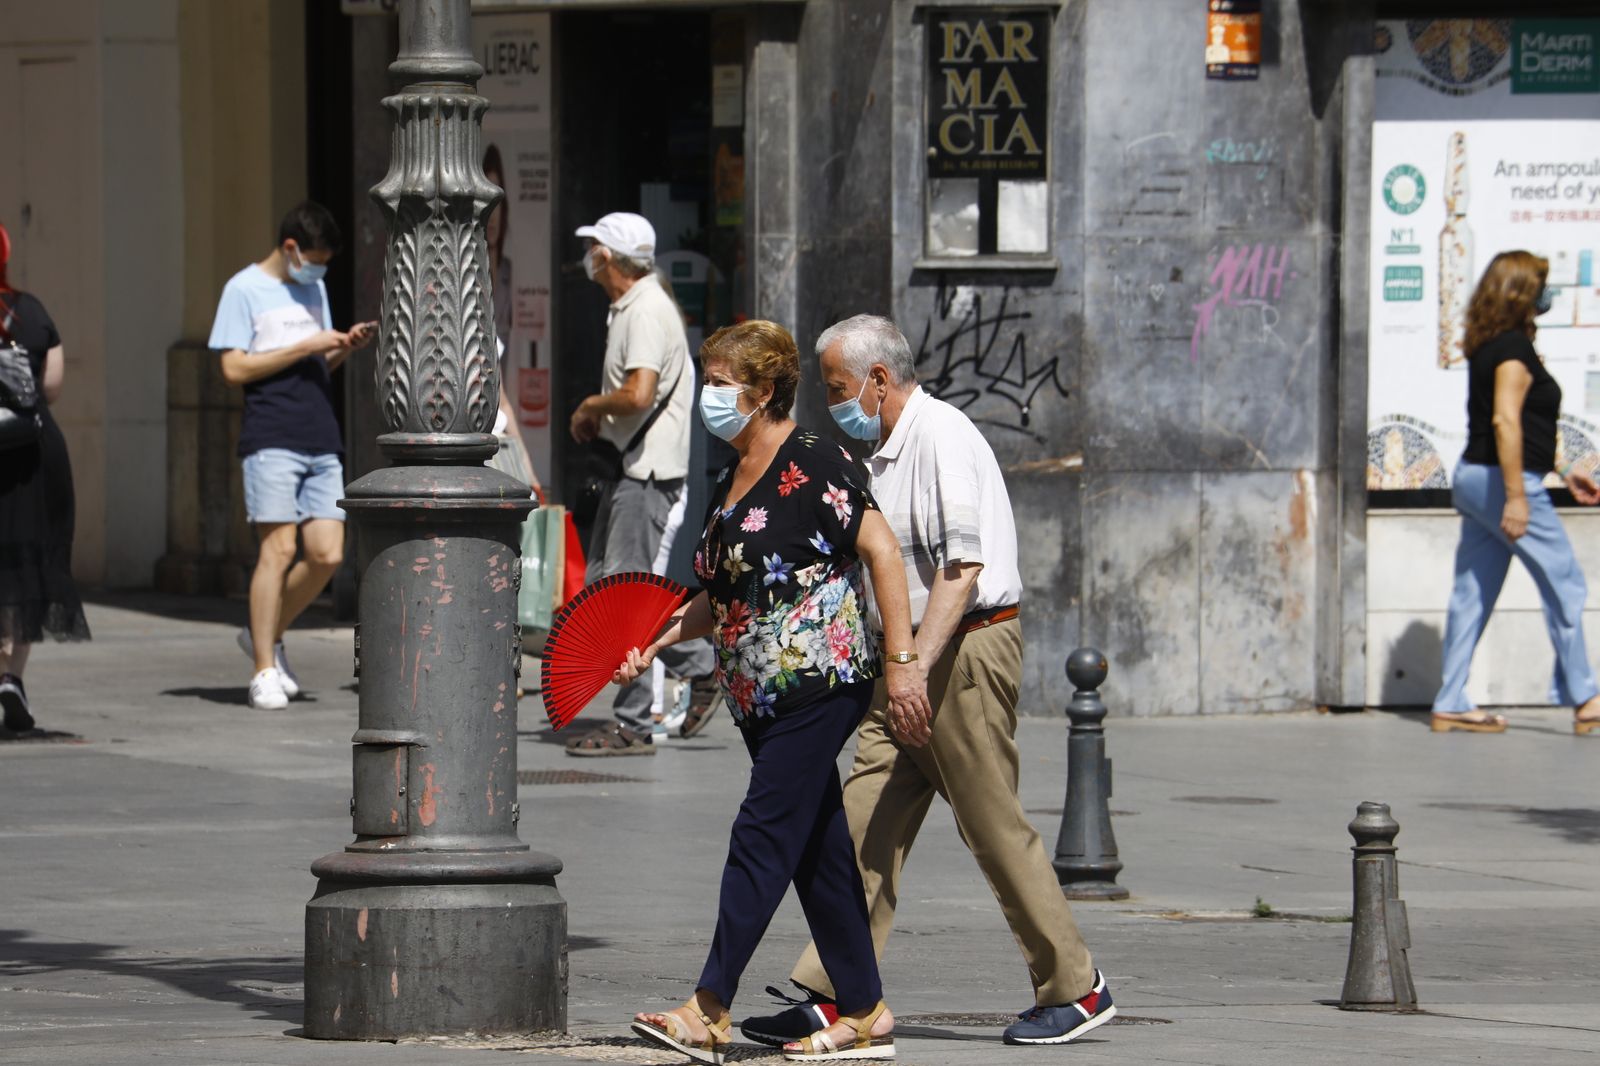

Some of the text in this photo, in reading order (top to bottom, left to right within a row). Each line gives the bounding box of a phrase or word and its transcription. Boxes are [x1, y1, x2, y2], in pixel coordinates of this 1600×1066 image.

[939, 20, 1039, 62] FAR
[1520, 32, 1593, 51] MARTI
[484, 42, 540, 75] LIERAC
[1520, 51, 1593, 72] DERM
[942, 66, 1027, 109] MA
[939, 110, 1042, 155] CIA
[1494, 158, 1600, 181] An ampoul
[1510, 181, 1559, 200] need
[1563, 181, 1584, 200] of
